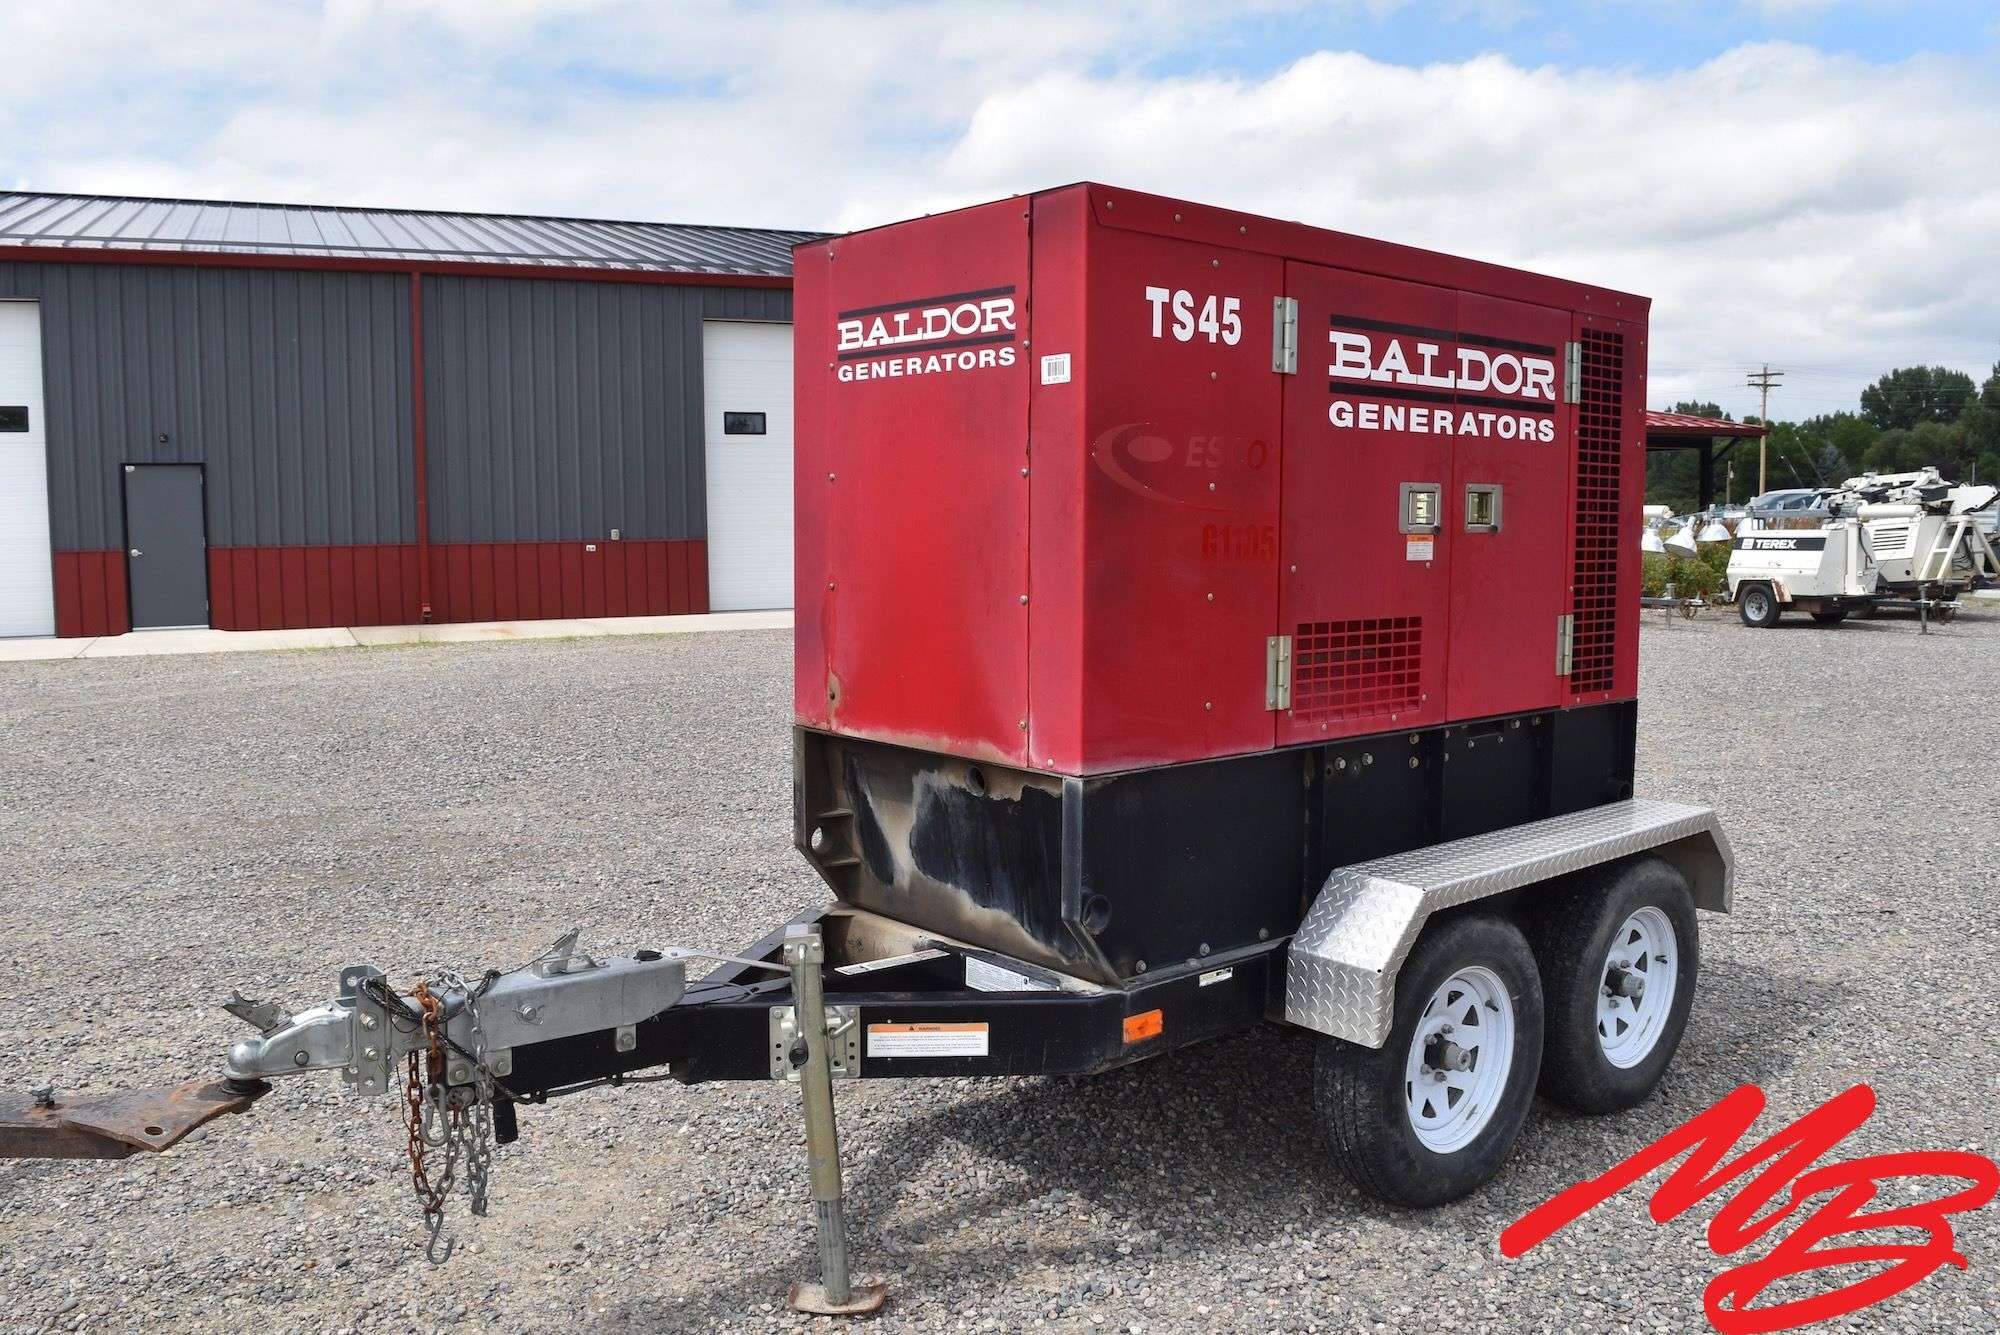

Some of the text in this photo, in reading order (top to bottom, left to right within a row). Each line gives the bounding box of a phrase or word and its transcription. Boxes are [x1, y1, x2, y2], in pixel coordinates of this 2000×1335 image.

[836, 297, 1017, 352] BALDOR
[1145, 285, 1242, 346] TS45
[836, 346, 1016, 384] GENERATORS
[1328, 330, 1556, 402] BALDOR
[1328, 401, 1556, 443] GENERATORS
[1755, 539, 1797, 550] TEREX
